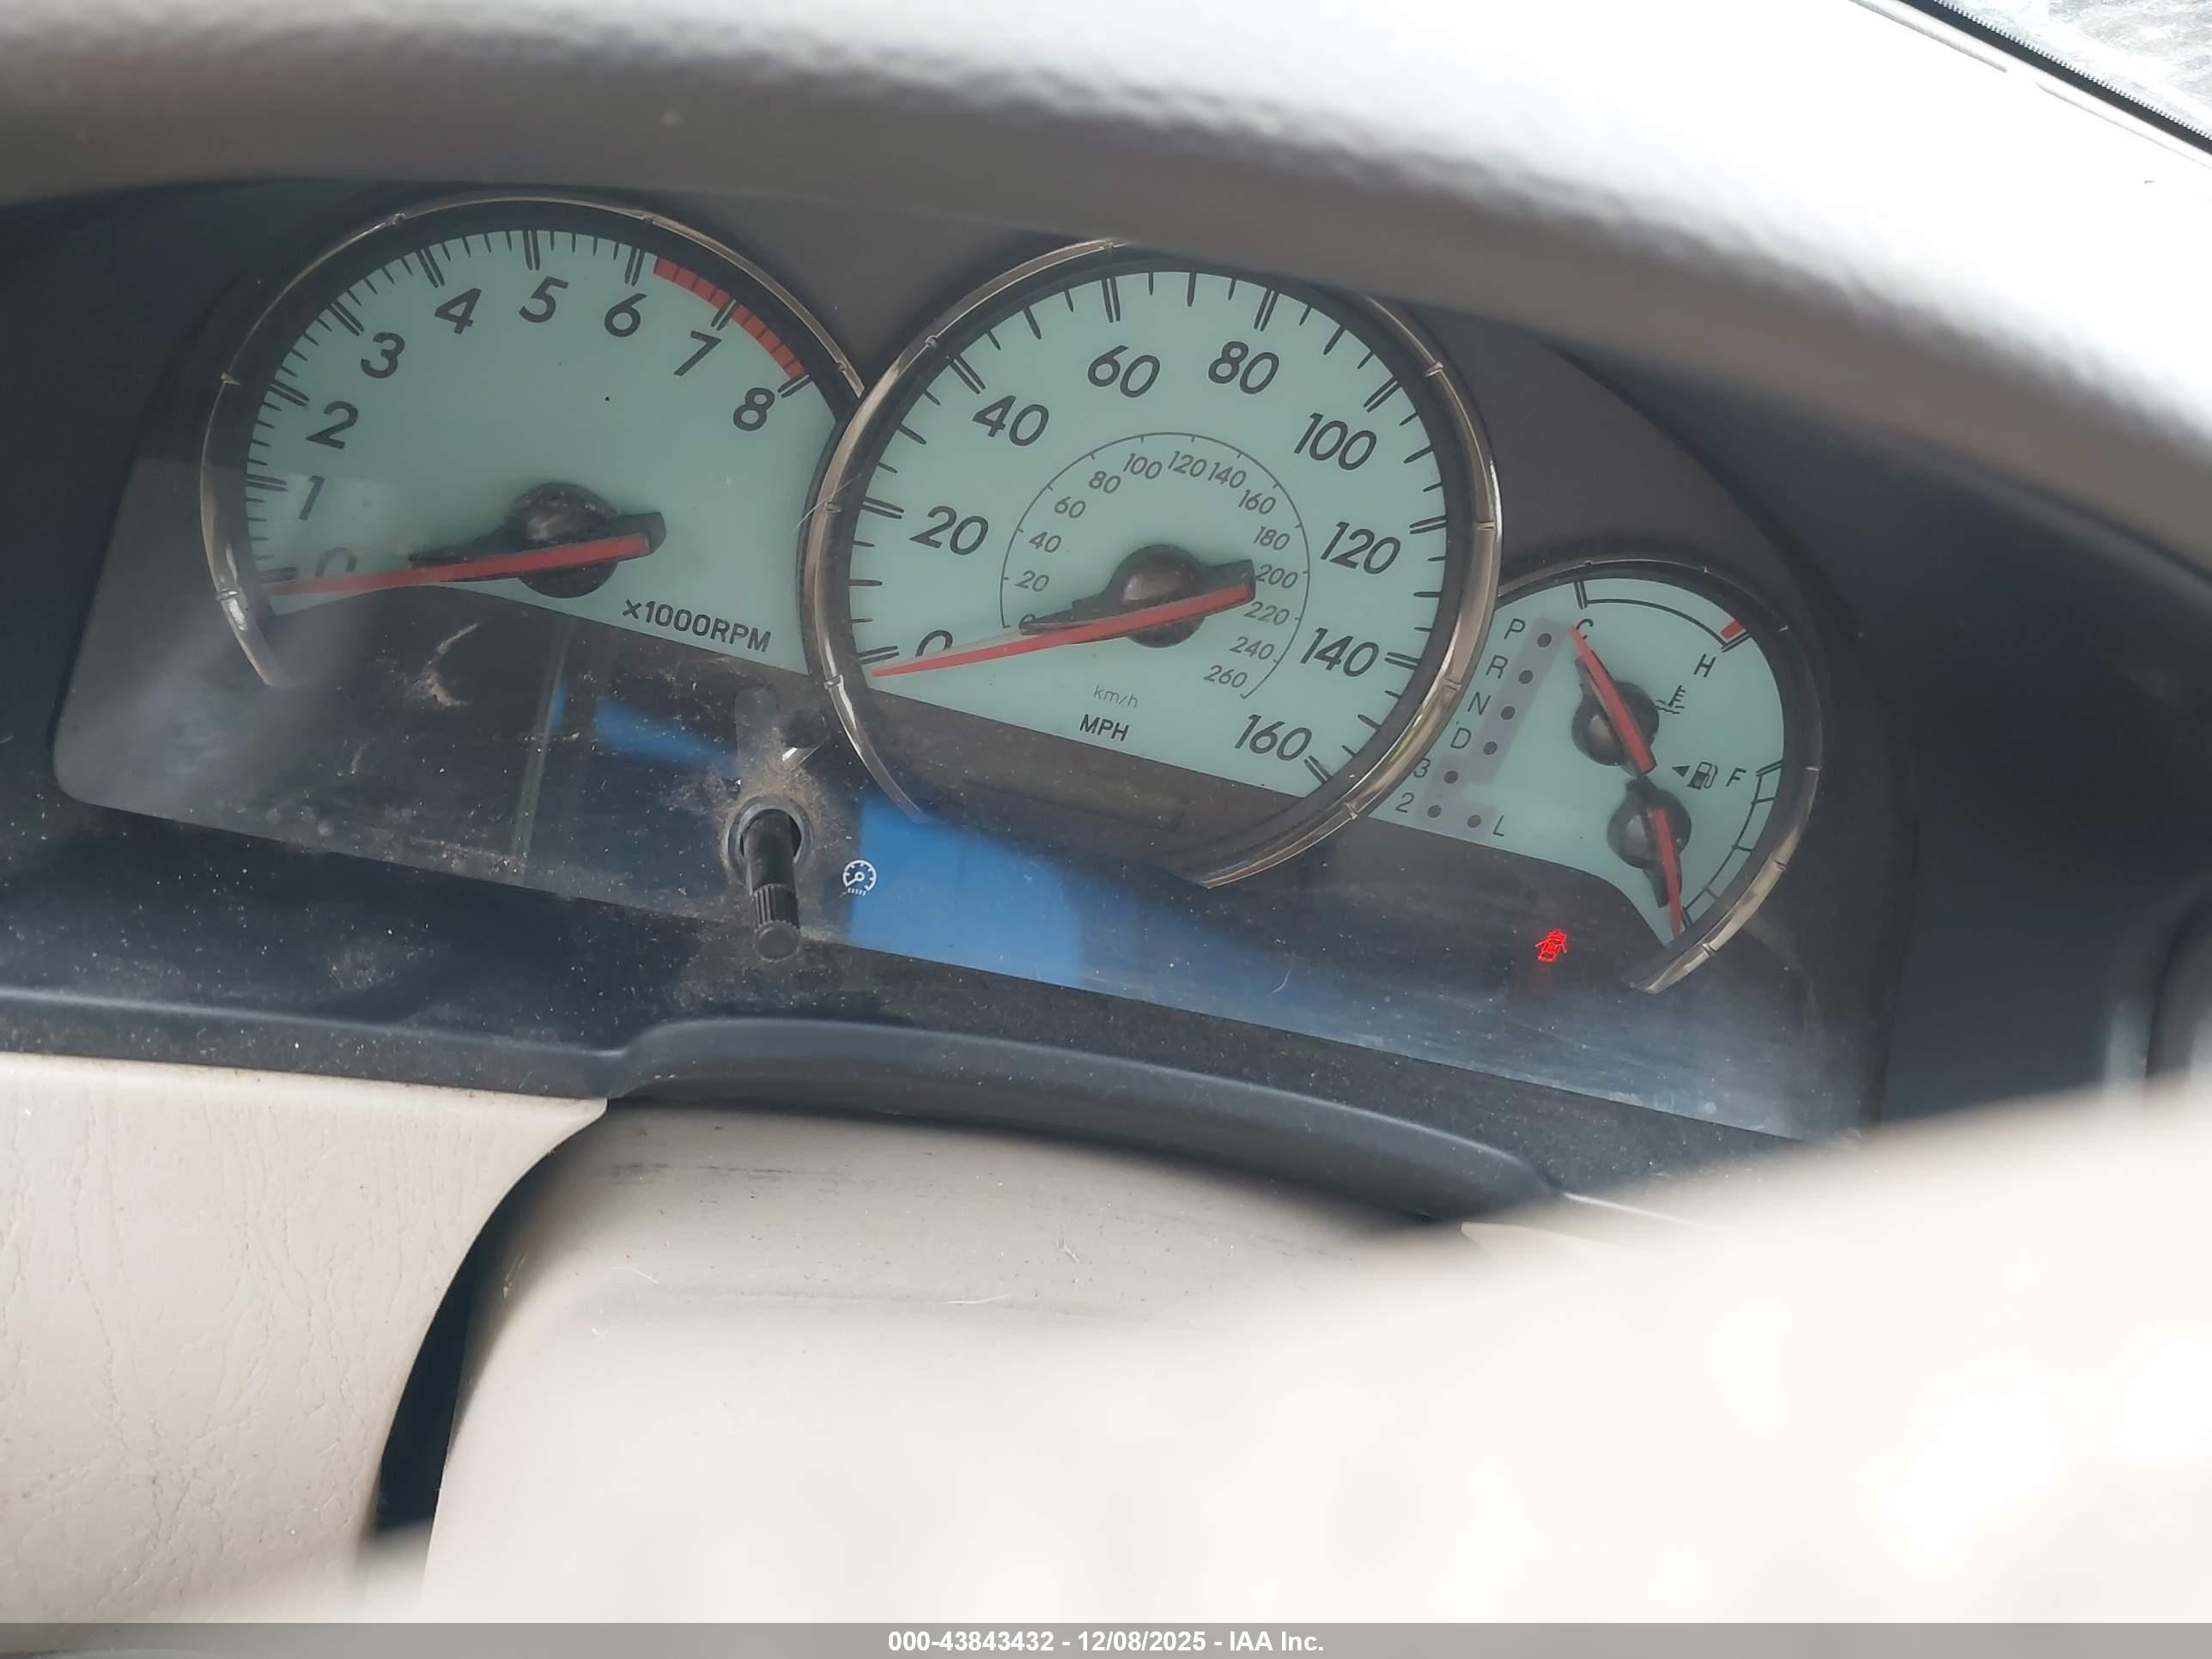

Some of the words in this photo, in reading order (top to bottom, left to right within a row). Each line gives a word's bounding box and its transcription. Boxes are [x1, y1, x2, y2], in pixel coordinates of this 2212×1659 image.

[434, 289, 482, 334] 4
[520, 276, 568, 322] 5
[605, 294, 647, 337] 6
[361, 332, 405, 378] 3
[674, 331, 721, 376] 7
[1088, 345, 1160, 398] 60
[1208, 342, 1279, 394] 80
[732, 387, 775, 431] 8
[972, 396, 1048, 446] 40
[306, 401, 358, 449] 2
[1294, 413, 1376, 471] 100
[1123, 453, 1162, 479] 100
[1168, 451, 1206, 477] 120
[1208, 463, 1246, 488] 140
[1089, 471, 1121, 493] 80
[299, 476, 325, 520] 1
[1054, 496, 1085, 519] 60
[1238, 489, 1276, 514] 160
[909, 506, 988, 556] 20
[1029, 532, 1061, 552] 40
[1253, 526, 1290, 550] 180
[1321, 522, 1401, 574] 120
[1015, 571, 1049, 592] 20
[1255, 564, 1298, 589] 200
[1243, 602, 1290, 625] 220
[1504, 618, 1525, 639] P
[1230, 636, 1274, 659] 240
[1300, 628, 1378, 677] 140
[1203, 665, 1247, 687] 260
[1486, 655, 1508, 678] R
[1693, 654, 1716, 678] H
[1093, 685, 1138, 708] km/h
[1468, 692, 1491, 715] N
[1079, 714, 1129, 741] MPH
[1235, 714, 1312, 761] 160
[1449, 728, 1471, 749] D
[1413, 758, 1431, 778] 3
[1726, 768, 1746, 787] F
[1395, 793, 1414, 812] 2
[1492, 816, 1505, 836] L
